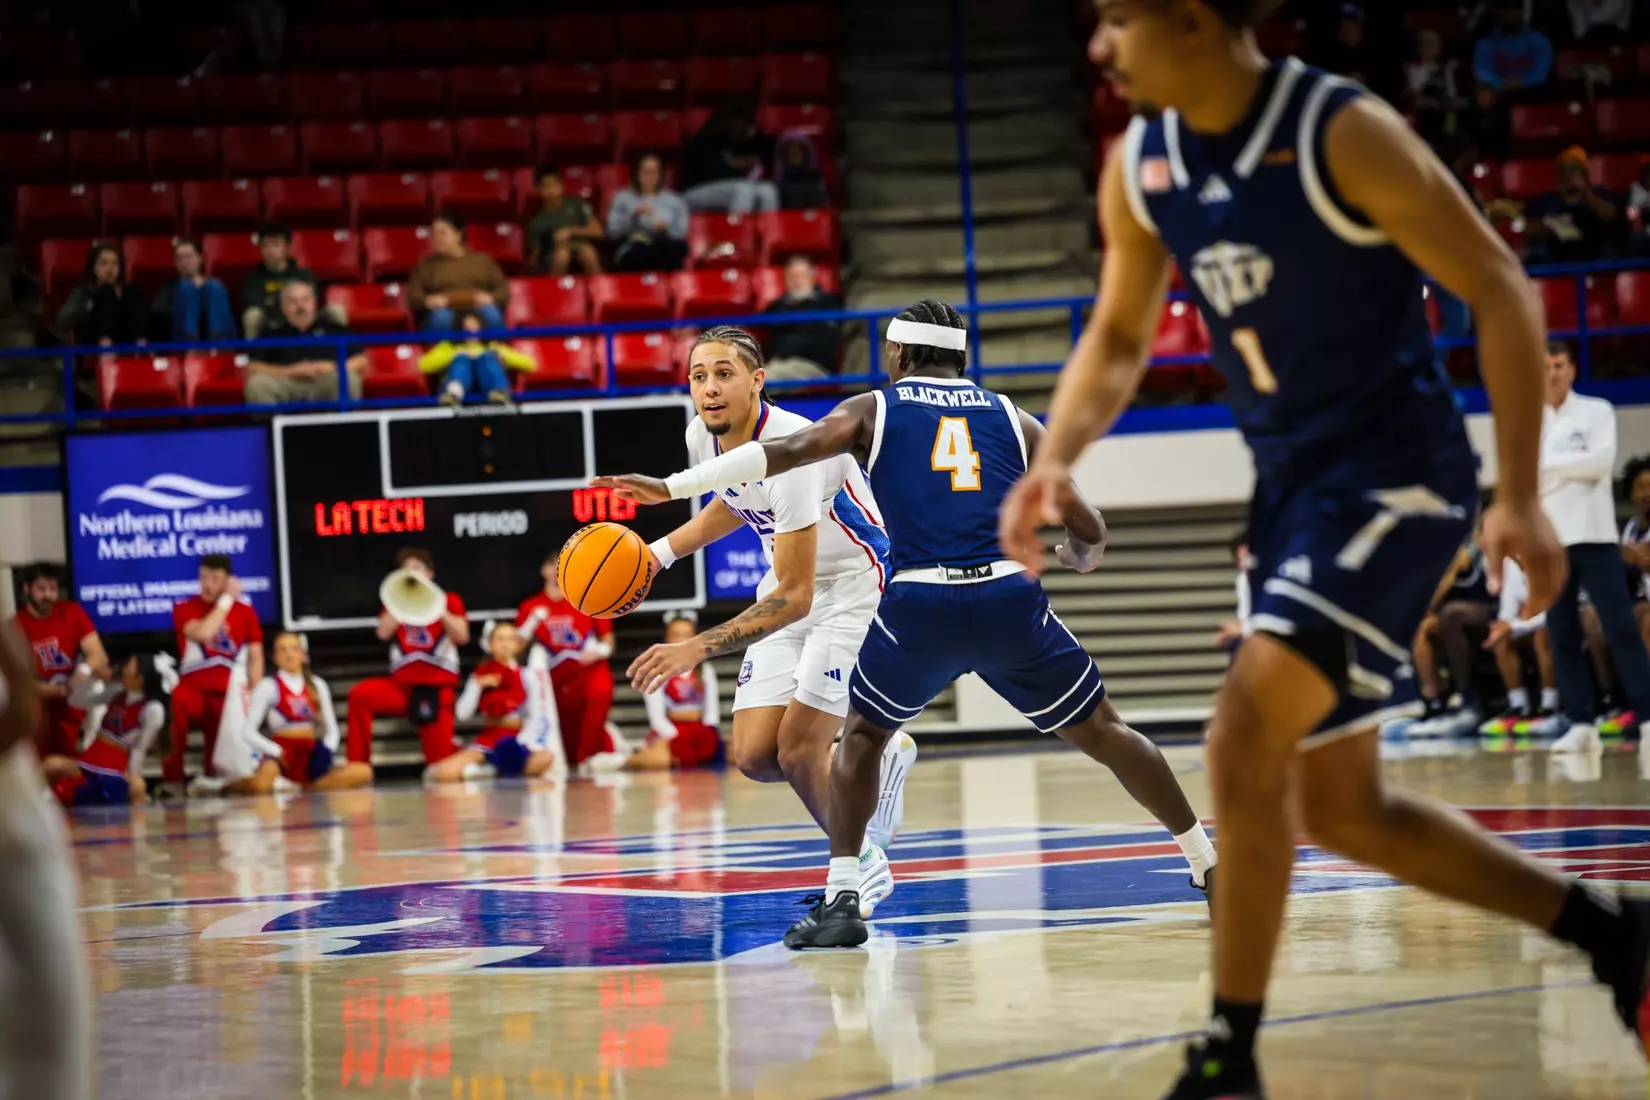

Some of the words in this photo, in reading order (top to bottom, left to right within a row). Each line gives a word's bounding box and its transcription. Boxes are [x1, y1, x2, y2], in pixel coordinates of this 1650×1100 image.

[1231, 327, 1278, 394] 1
[896, 386, 992, 407] BLACKWELL
[931, 416, 981, 492] 4
[79, 509, 170, 537] Northern
[173, 504, 264, 532] Louisiana
[454, 510, 528, 538] PERIOD
[97, 532, 177, 560] Medical
[178, 529, 249, 556] Center
[612, 561, 652, 615] Wilson
